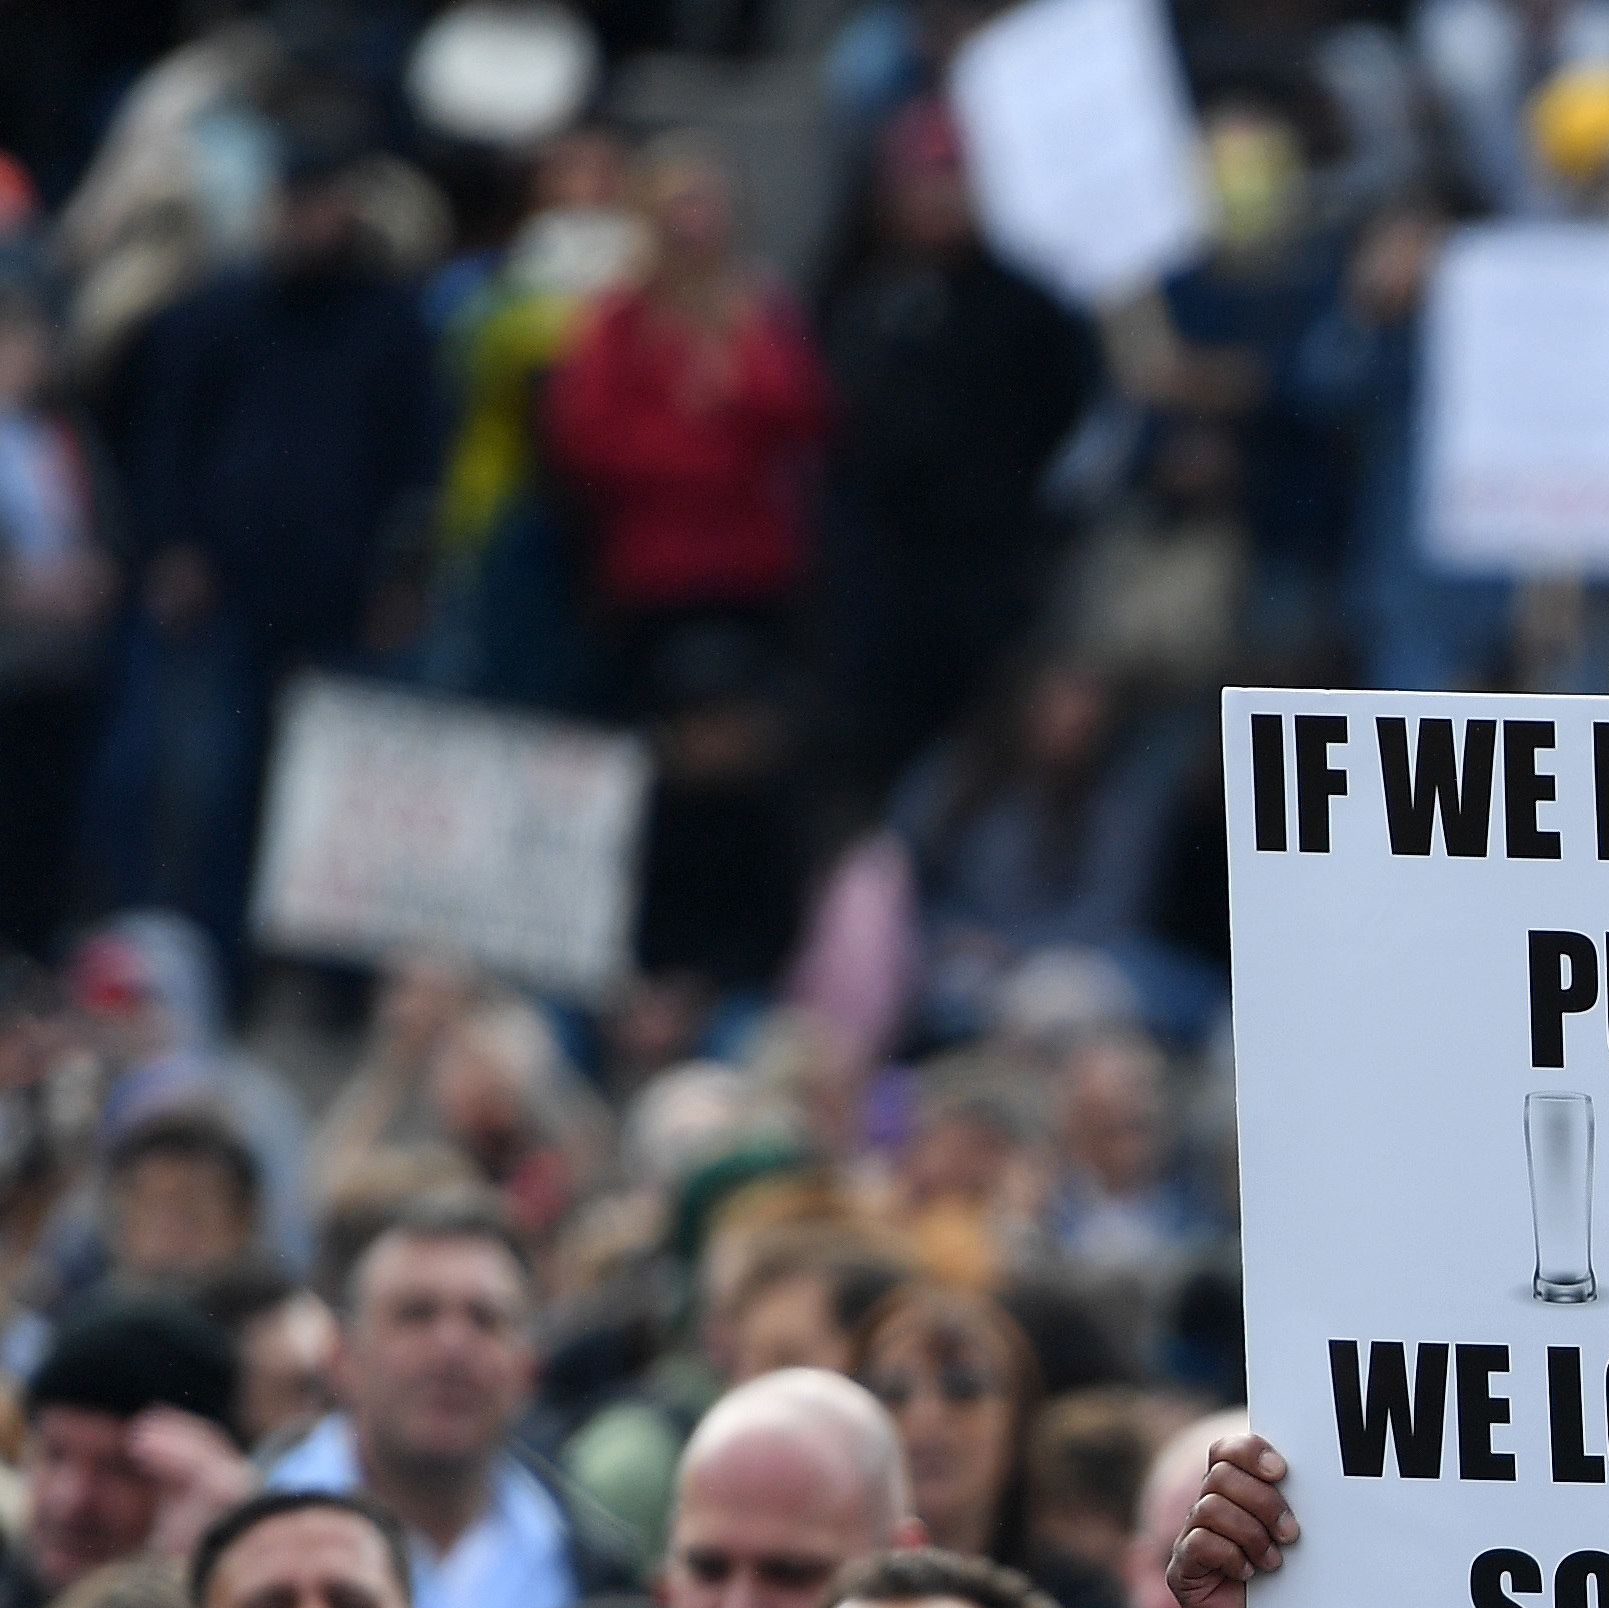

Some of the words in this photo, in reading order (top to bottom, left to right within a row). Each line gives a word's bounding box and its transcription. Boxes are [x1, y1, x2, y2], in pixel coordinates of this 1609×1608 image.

[1249, 713, 1349, 855] IF
[1375, 716, 1562, 861] WE
[1327, 1340, 1517, 1484] WE
